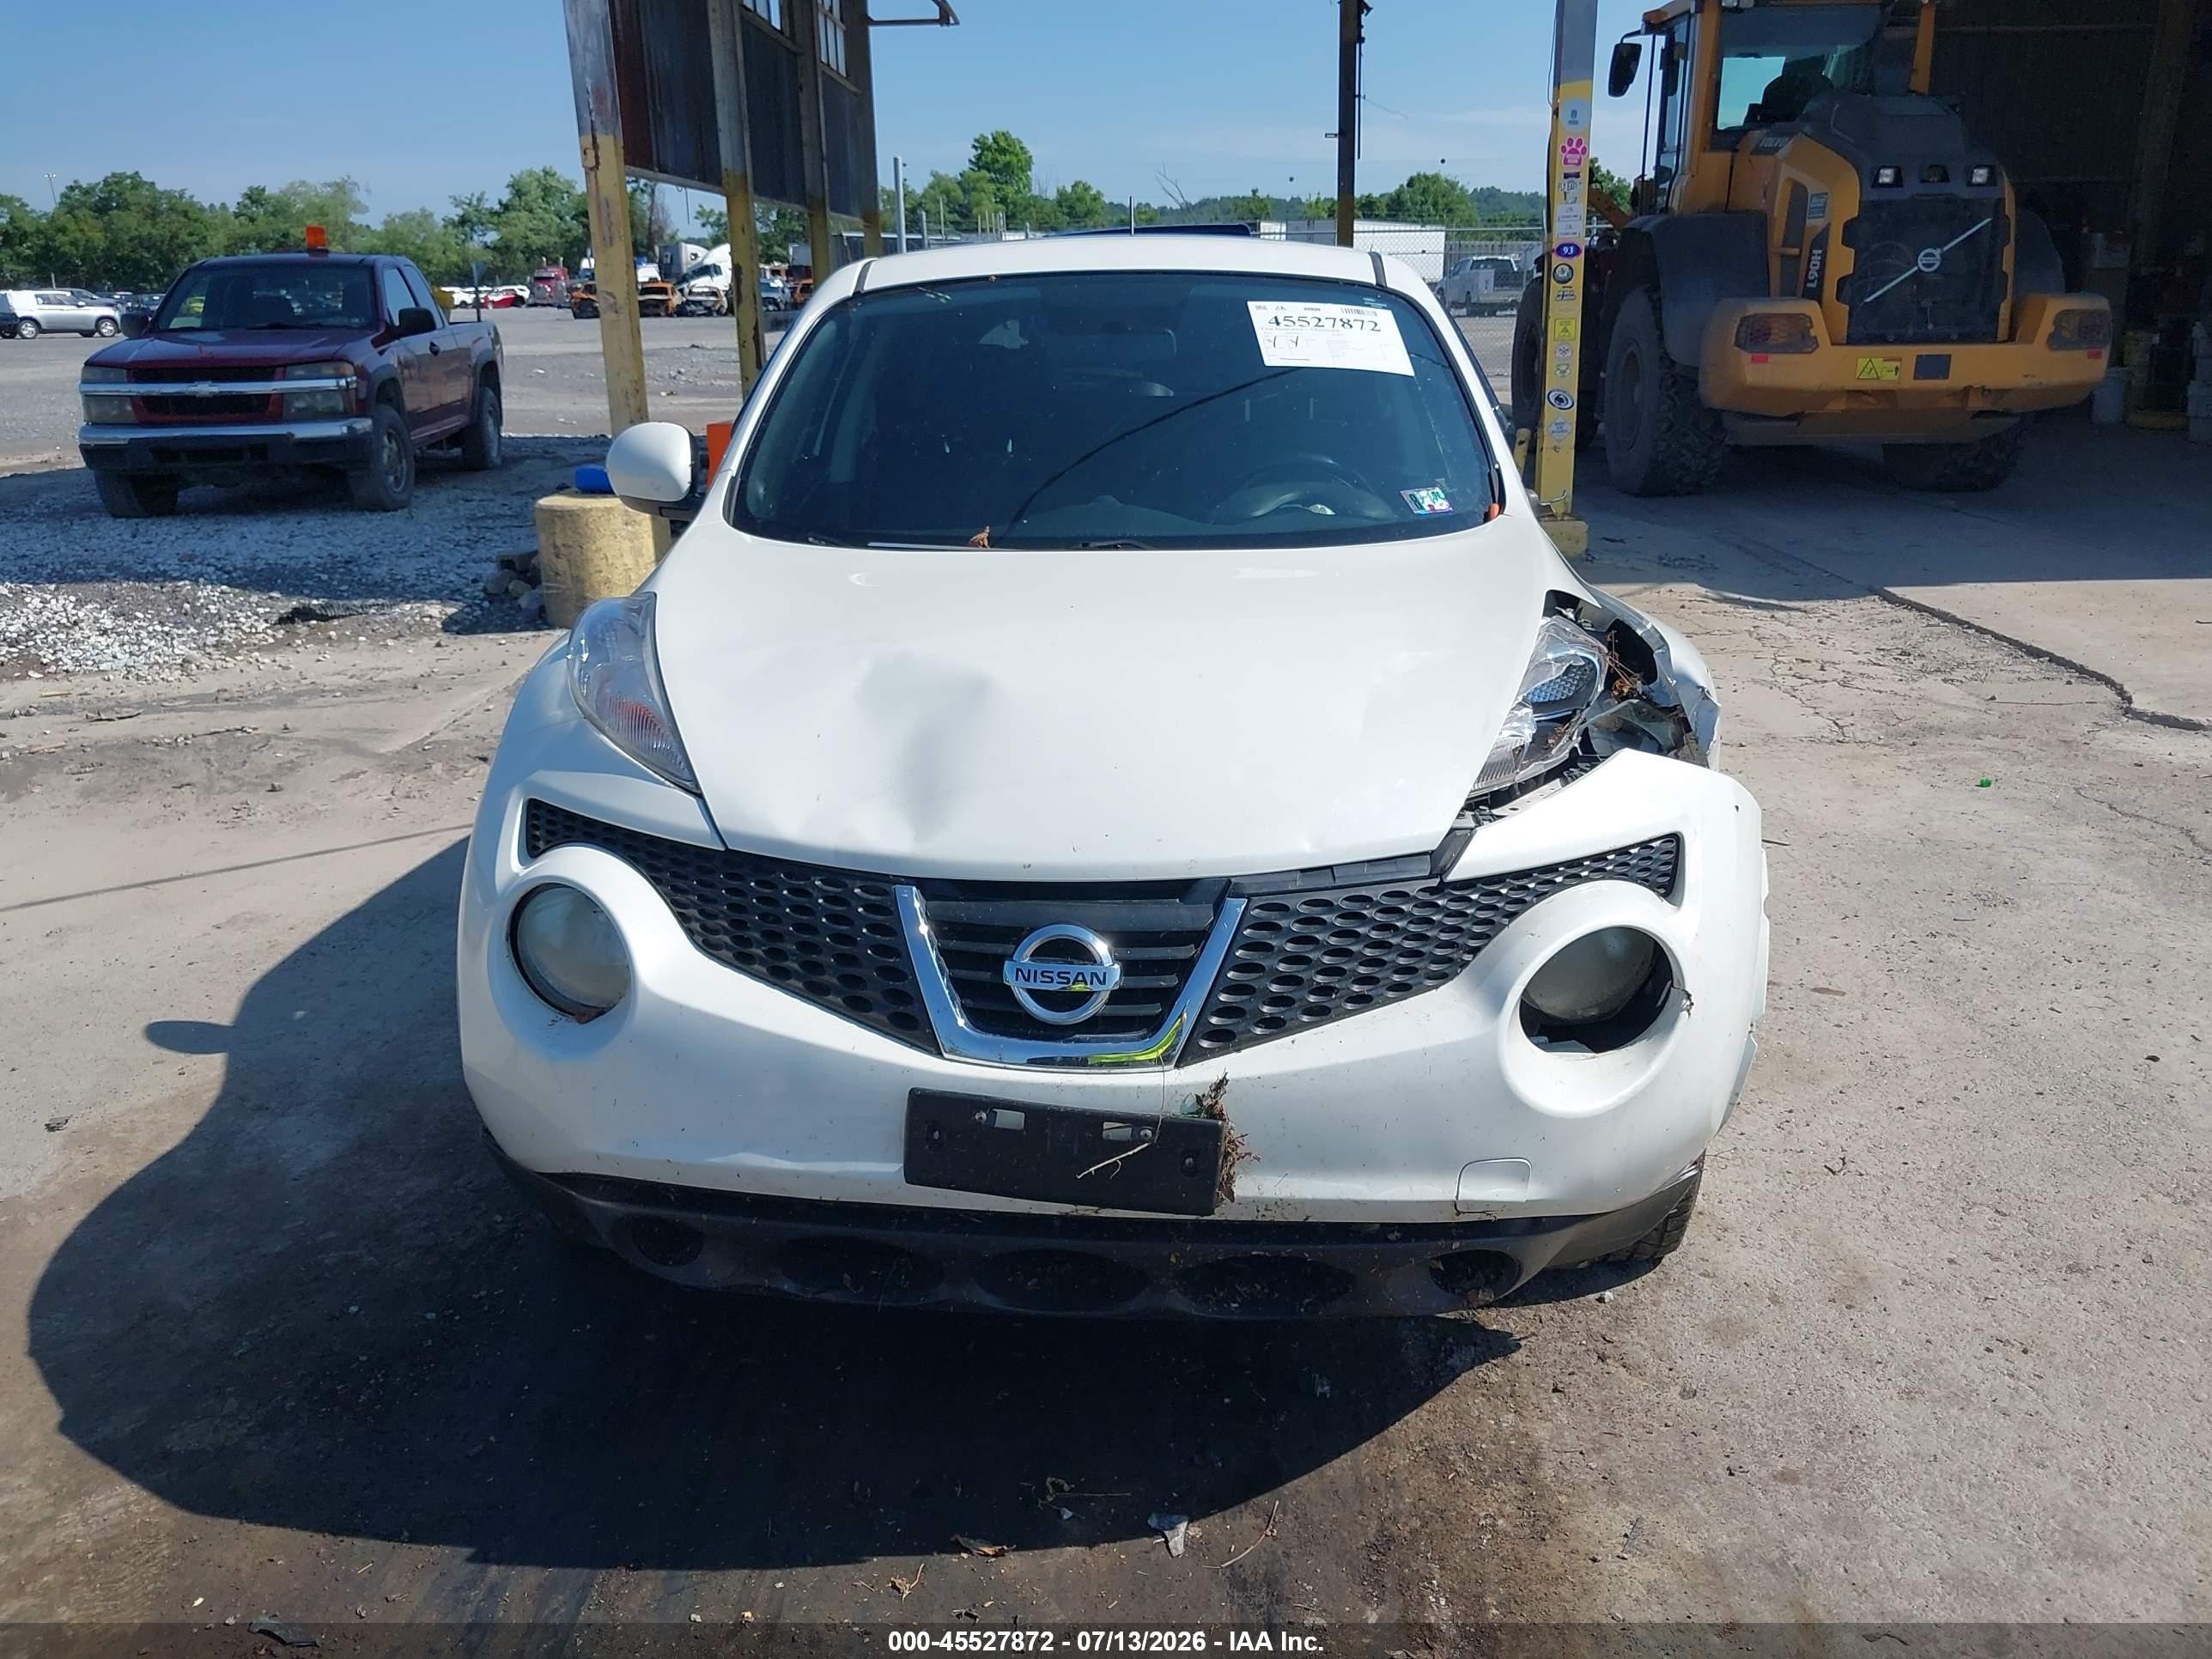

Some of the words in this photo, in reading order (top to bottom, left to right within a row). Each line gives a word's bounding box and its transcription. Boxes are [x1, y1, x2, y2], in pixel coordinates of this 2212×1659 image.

[1563, 246, 1574, 255] 93
[1807, 250, 1823, 288] L90H
[1267, 315, 1382, 332] 45527872
[1015, 967, 1107, 986] NISSAN
